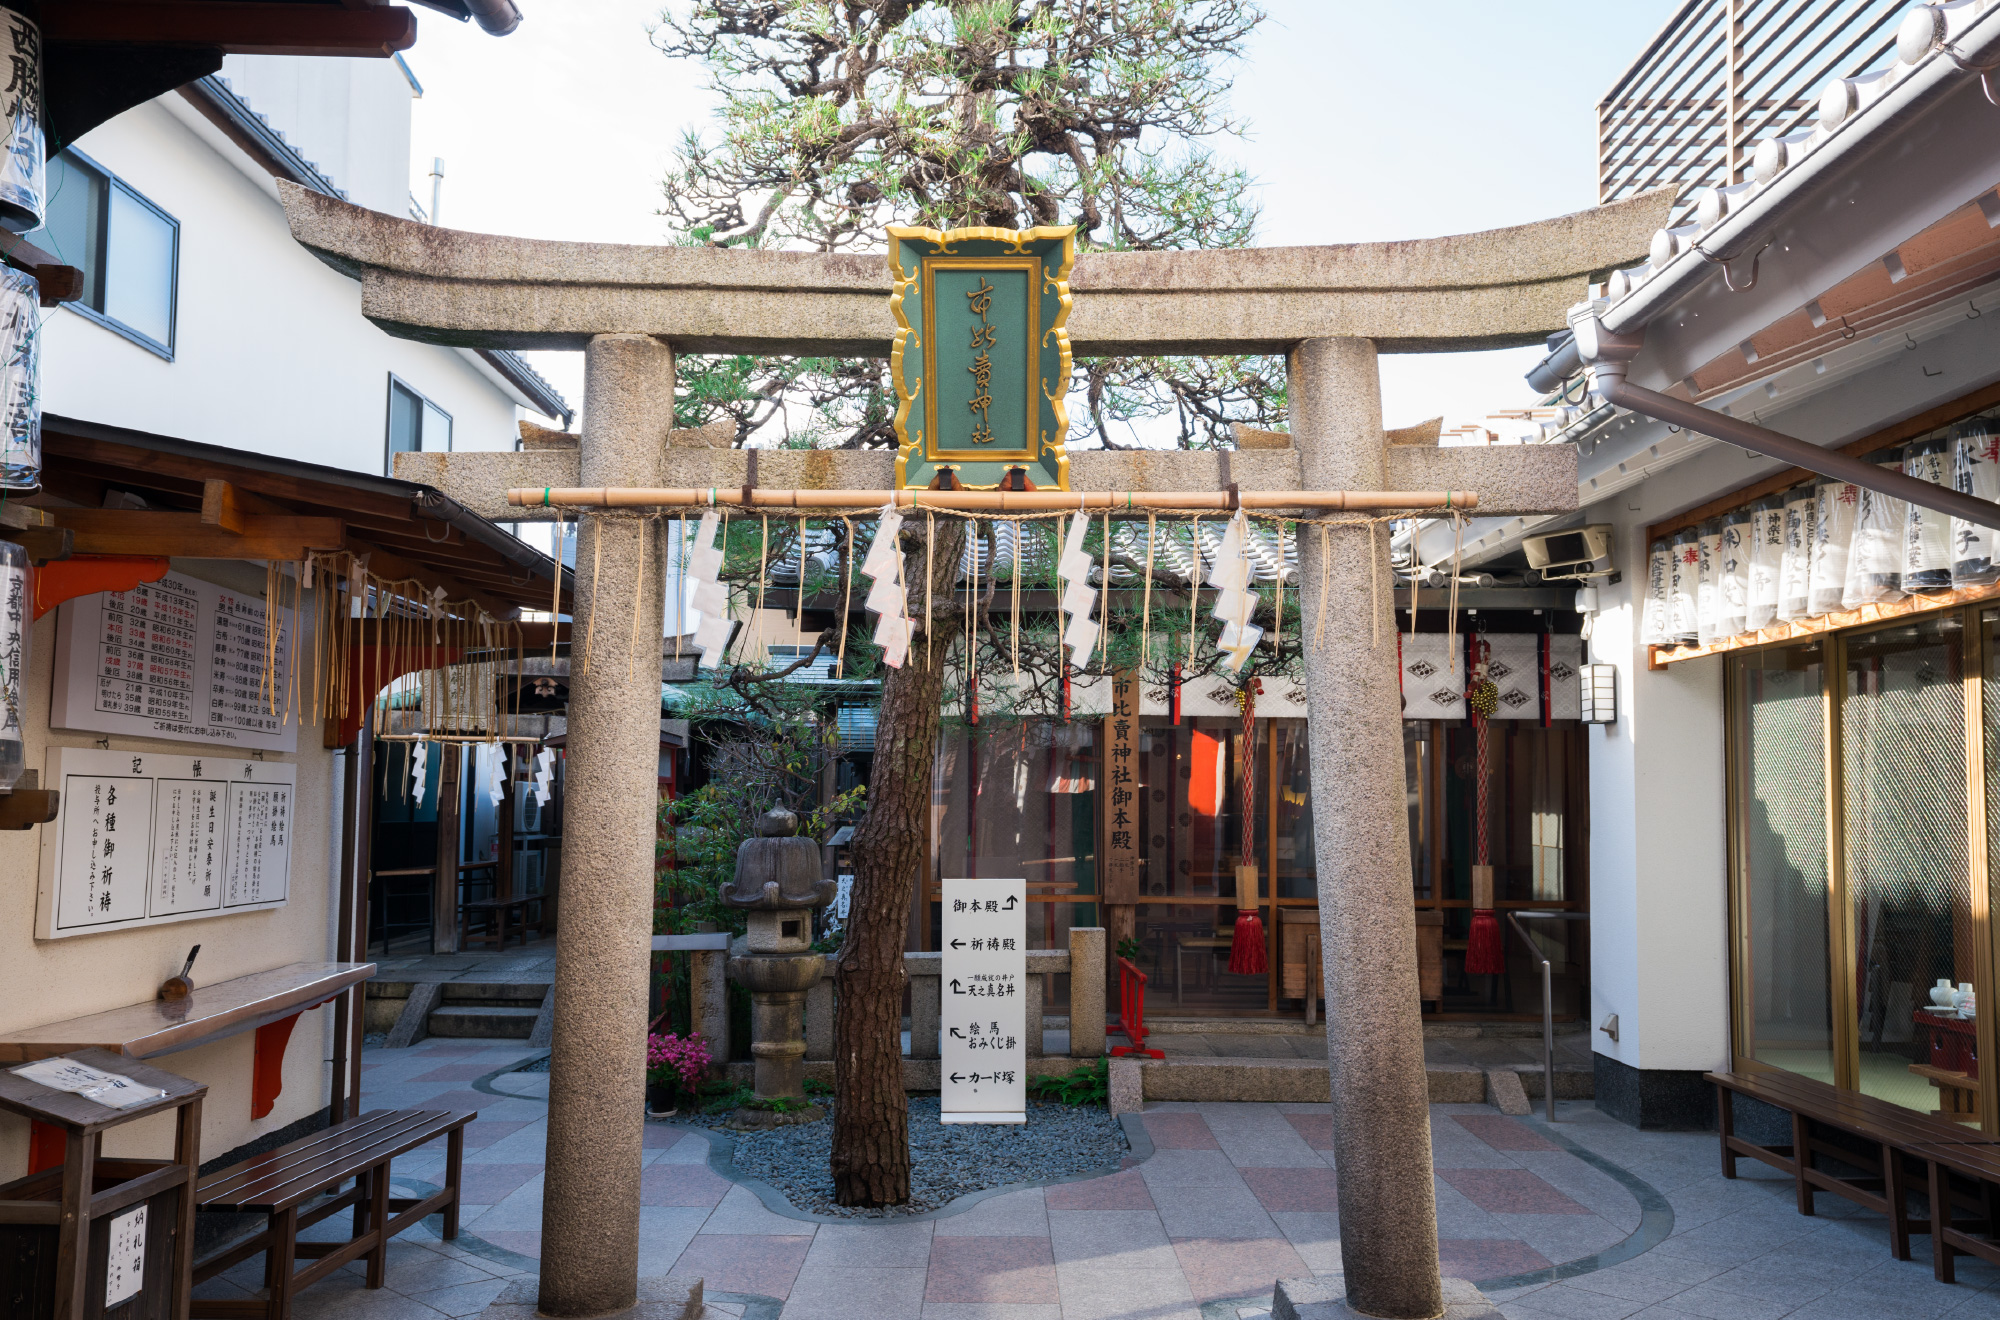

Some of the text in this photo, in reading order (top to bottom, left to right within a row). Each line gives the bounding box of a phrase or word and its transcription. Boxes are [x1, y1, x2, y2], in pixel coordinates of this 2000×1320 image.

[966, 276, 997, 445] 市比賣神社
[1927, 457, 1942, 486] 名古
[1767, 513, 1783, 546] 神楽坂
[1682, 547, 1699, 566] 奉
[1, 574, 22, 731] 京都中央信用金庫
[1111, 677, 1132, 850] 市比賣神社御本殿
[99, 785, 117, 912] 各種御祈祷
[953, 899, 999, 914] 御本殿
[970, 937, 1016, 951] 祈祷殿
[967, 983, 1015, 997] 天之真名井
[969, 1021, 1000, 1035] 絵馬
[968, 1036, 1017, 1050] おみくじ掛
[968, 1070, 1016, 1085] カード塚
[132, 1210, 145, 1273] 納札箱
